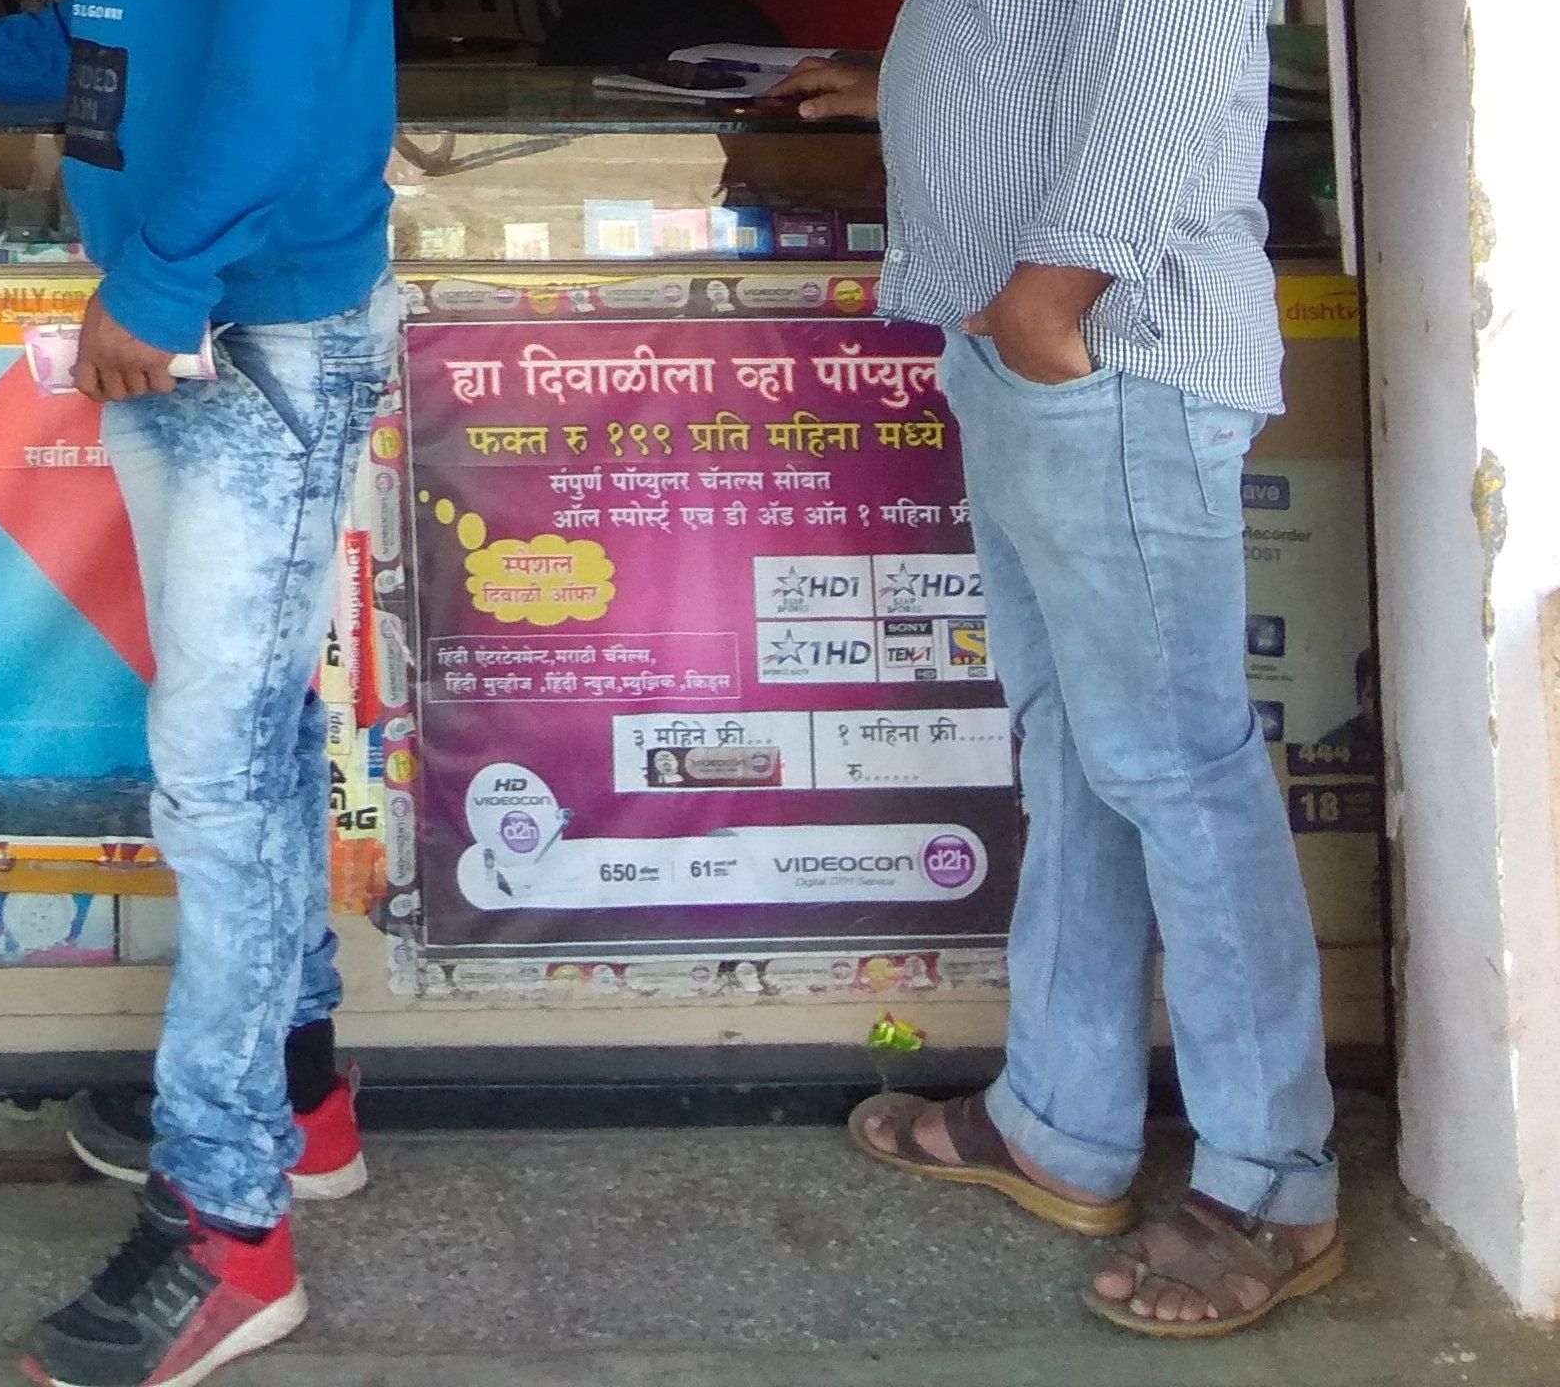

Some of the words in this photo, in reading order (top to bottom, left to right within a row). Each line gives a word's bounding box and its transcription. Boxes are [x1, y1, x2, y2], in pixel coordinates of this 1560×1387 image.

[445, 357, 503, 403] ह्या
[519, 343, 716, 406] दिवाळीला
[732, 355, 795, 401] व्हा
[466, 425, 548, 457] फक्त
[563, 426, 588, 456] रु
[606, 422, 672, 457] १९९
[687, 410, 751, 453] प्रति
[764, 410, 861, 458] महिना
[874, 409, 946, 453] मध्ये
[610, 466, 691, 500] पॉप्युलर
[698, 466, 765, 491] चॅनल्स
[553, 503, 601, 528] ऑल
[680, 506, 715, 530] एच
[722, 501, 748, 526] डी
[805, 501, 848, 526] ऑन
[858, 504, 871, 527] १
[879, 498, 941, 528] महिना
[501, 548, 574, 577] स्पेशल
[482, 581, 542, 604] दिवाळी
[550, 581, 598, 604] ऑफर
[808, 575, 860, 599] HD1
[920, 573, 985, 598] HD2
[437, 645, 468, 666] हिंदी
[810, 640, 872, 667] 1HD
[445, 671, 477, 693] हिंदी
[633, 729, 646, 750] ३
[654, 720, 708, 747] महिने
[838, 724, 851, 748] १
[859, 719, 920, 745] महिना
[493, 778, 529, 792] HD
[473, 796, 553, 807] VIDEOCON
[337, 806, 379, 832] 4G
[502, 821, 539, 840] d2h
[599, 862, 638, 883] 650
[689, 859, 713, 880] 61
[773, 854, 914, 876] VIDEOCON
[925, 845, 972, 876] d2h
